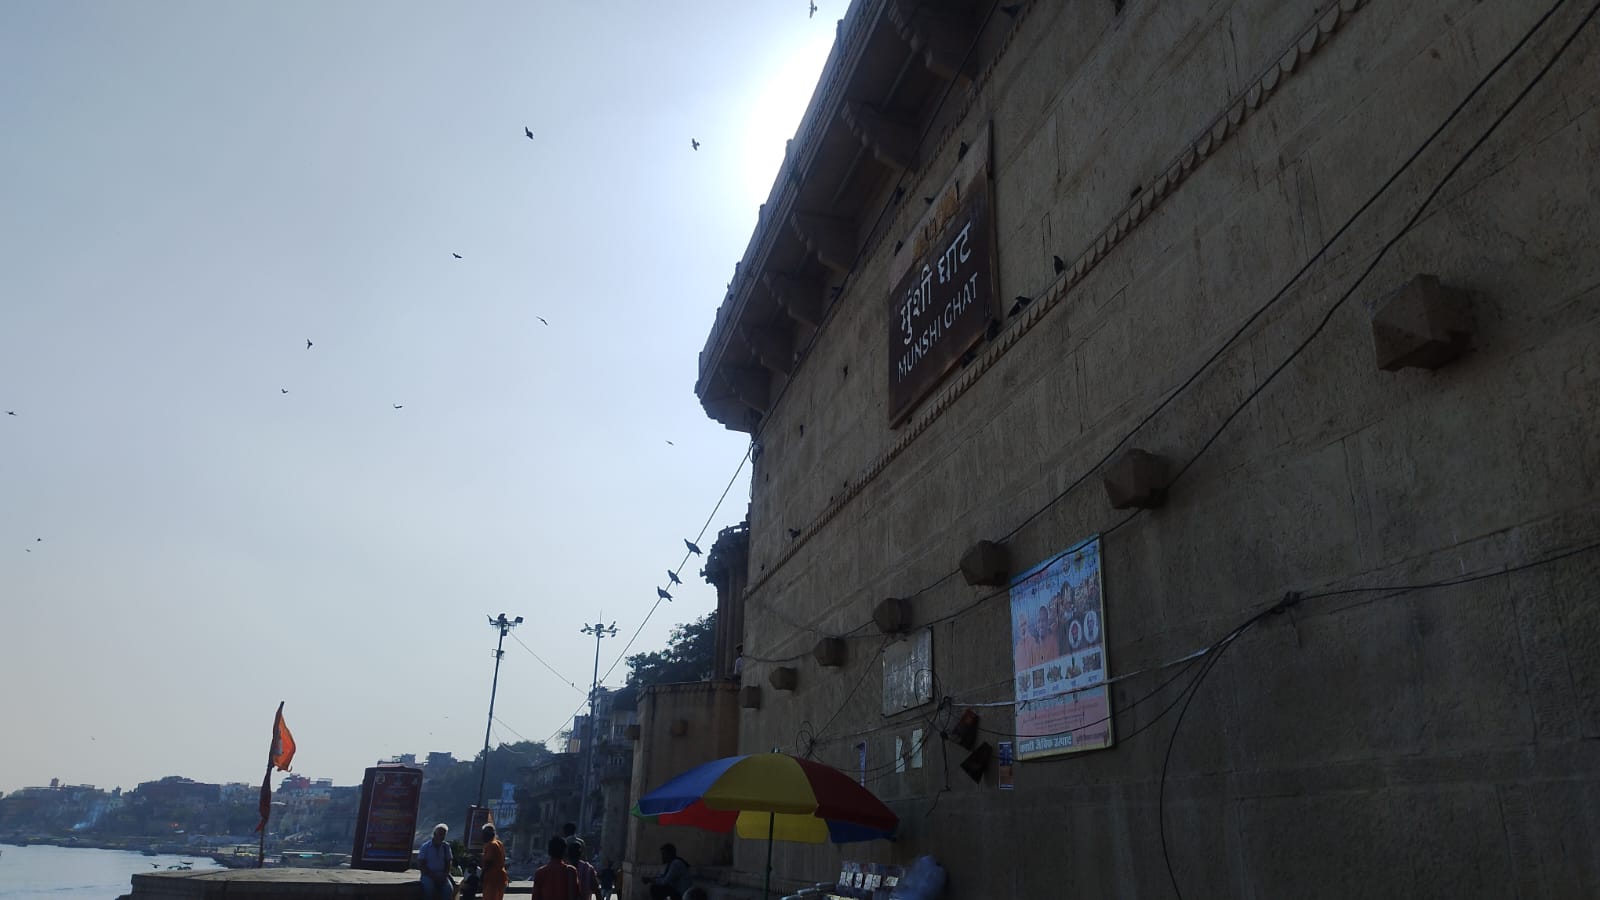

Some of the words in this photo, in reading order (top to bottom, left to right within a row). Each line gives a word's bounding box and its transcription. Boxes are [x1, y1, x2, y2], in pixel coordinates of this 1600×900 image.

[898, 315, 941, 382] MUNSHI
[944, 272, 978, 329] GHAT
[900, 263, 933, 345] मुंशी
[937, 220, 971, 284] घाट
